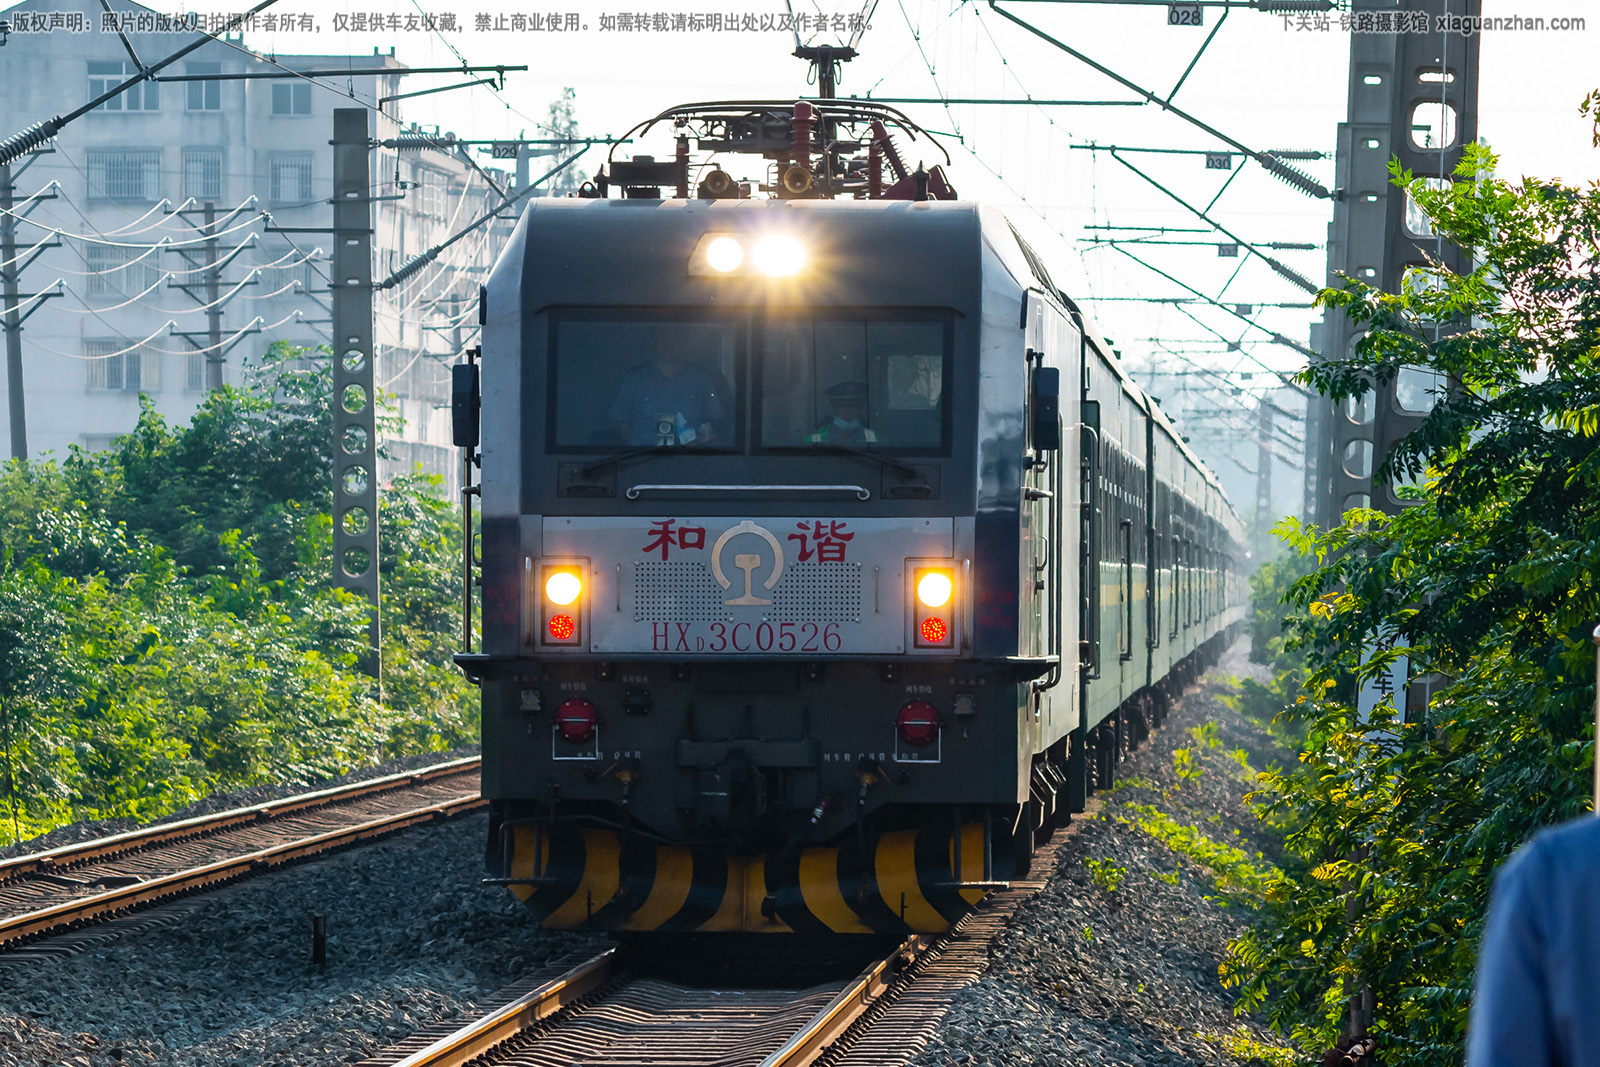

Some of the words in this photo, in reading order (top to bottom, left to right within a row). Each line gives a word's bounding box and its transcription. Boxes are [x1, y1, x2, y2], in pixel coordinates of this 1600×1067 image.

[1169, 10, 1202, 25] 028
[493, 147, 518, 158] 029
[1206, 158, 1230, 169] 030
[642, 518, 705, 561] 和
[788, 520, 855, 563] 谐
[651, 623, 842, 651] HXD3C0526
